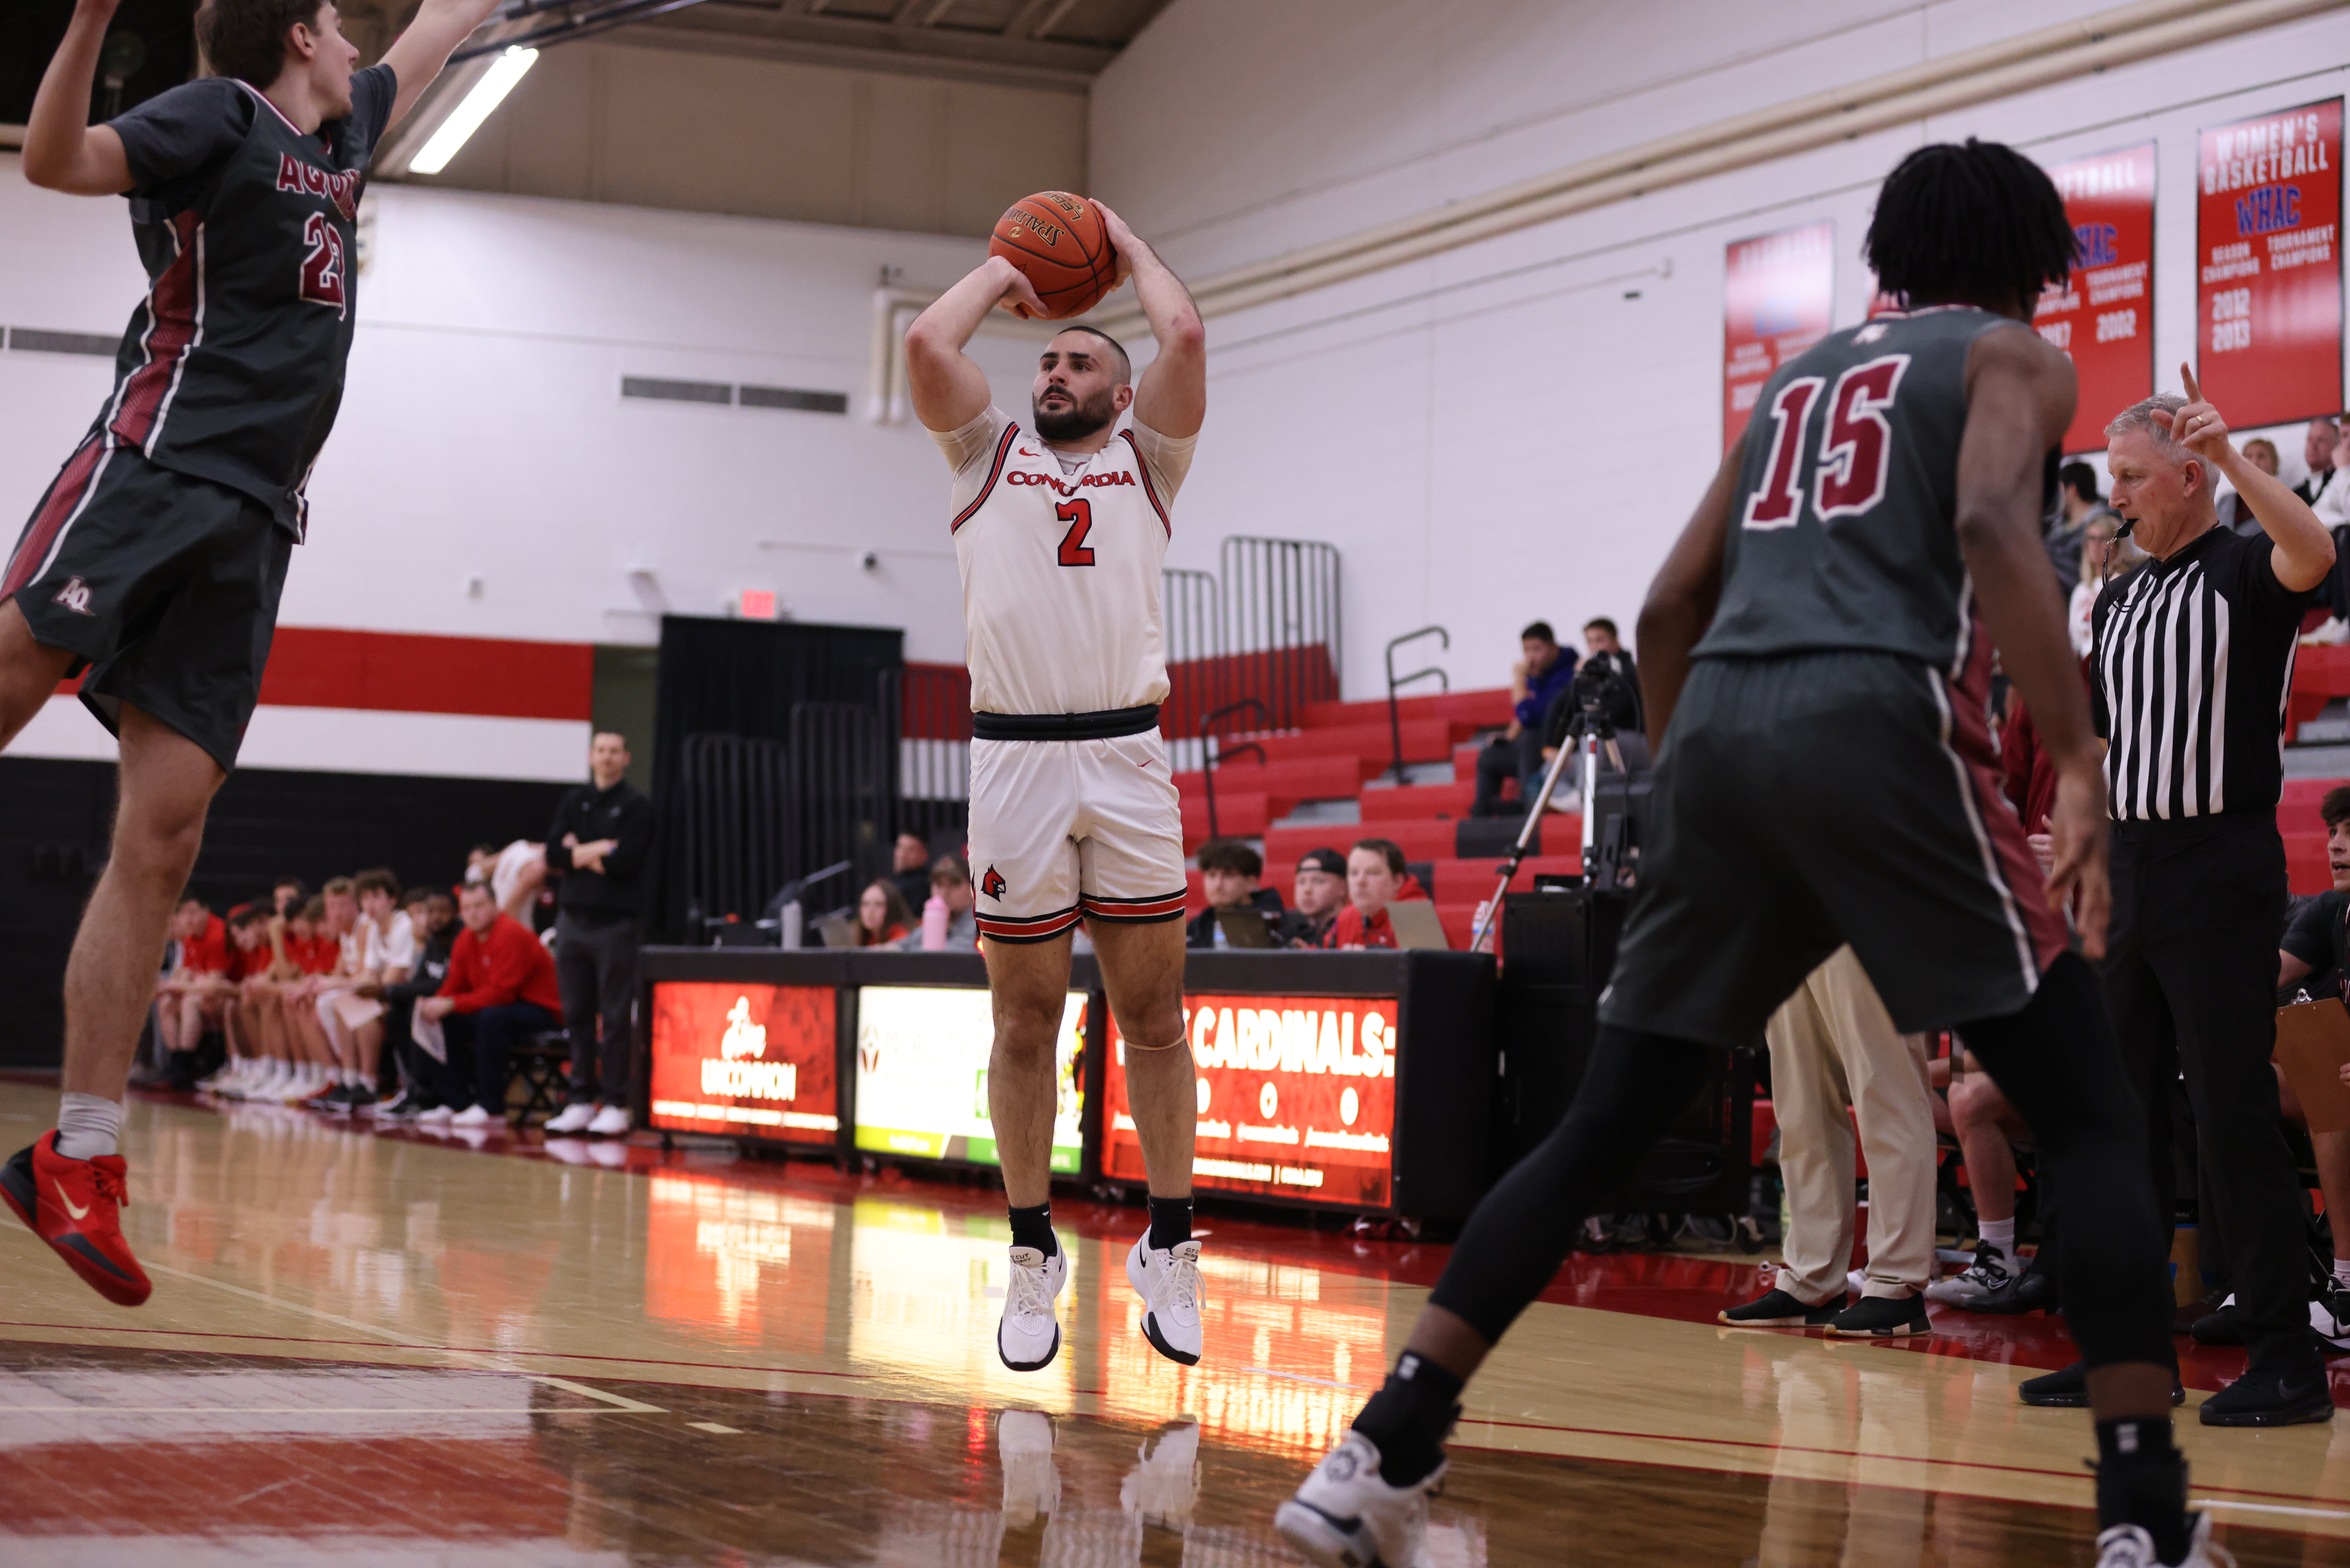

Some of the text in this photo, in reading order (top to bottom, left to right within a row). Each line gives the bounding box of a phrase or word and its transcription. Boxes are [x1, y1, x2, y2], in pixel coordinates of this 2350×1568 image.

[2216, 113, 2319, 162] WOMEN'S
[2204, 140, 2329, 195] BASKETBALL
[2236, 184, 2301, 237] WHAC
[2070, 222, 2118, 269] HAC
[2267, 224, 2335, 252] TOURNAMENT
[2271, 245, 2330, 271] CHAMPIONS
[2202, 257, 2260, 284] CHAMPIONS
[2212, 288, 2250, 321] 2012
[2212, 319, 2250, 353] 2013
[1742, 354, 1911, 530] 15
[1055, 498, 1095, 567] 2
[1192, 1005, 1396, 1078] CARDINALS:
